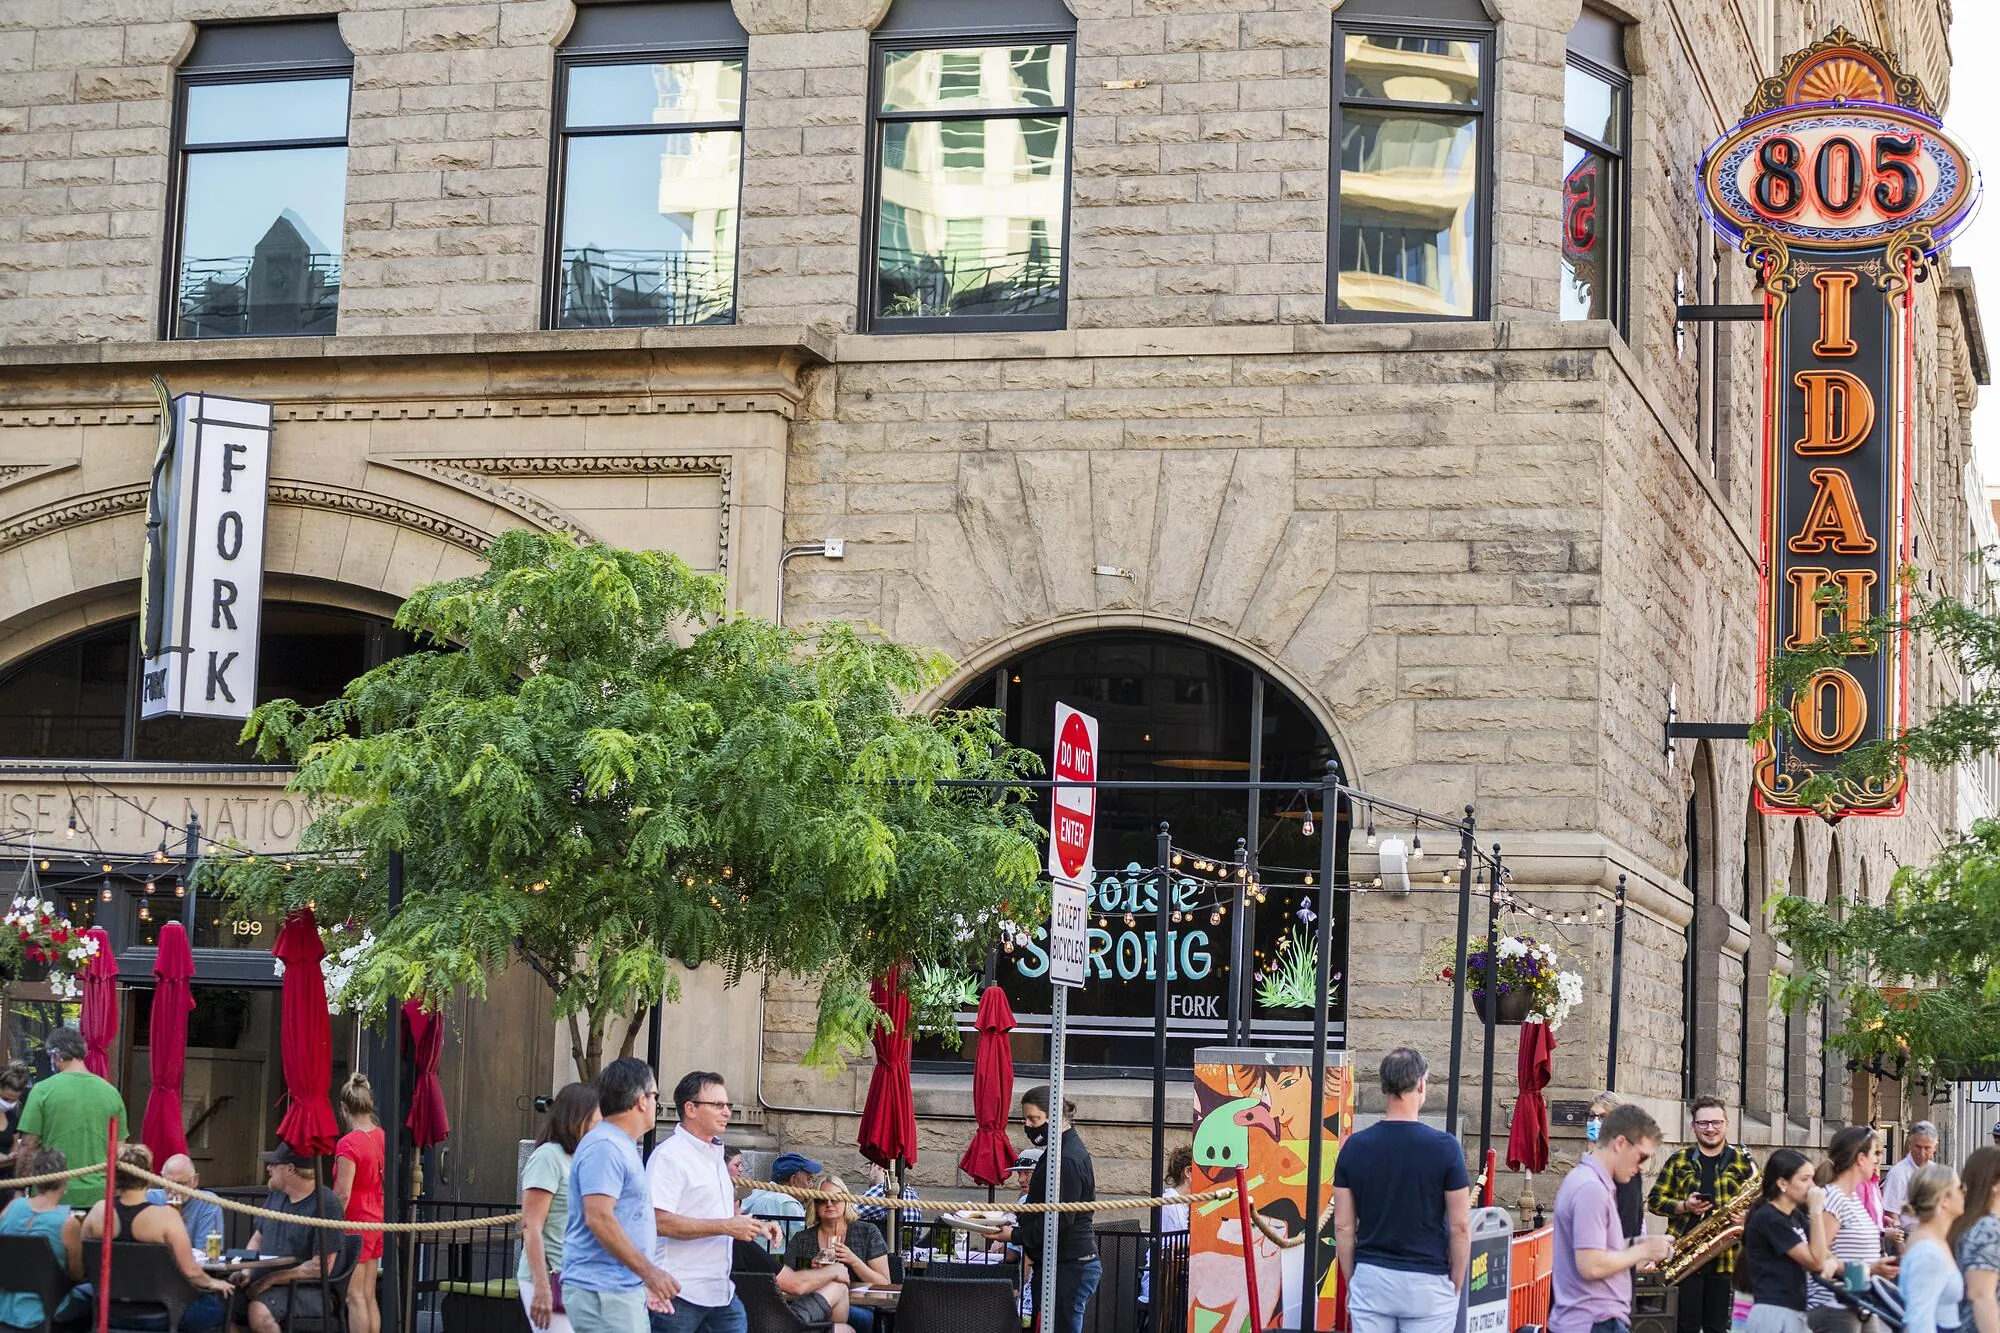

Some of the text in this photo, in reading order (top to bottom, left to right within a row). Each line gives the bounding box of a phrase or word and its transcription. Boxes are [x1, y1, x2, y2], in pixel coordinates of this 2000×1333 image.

[1752, 134, 1925, 219] 805
[1784, 270, 1878, 754] IDAHO
[205, 443, 248, 703] FORK
[1061, 740, 1091, 776] DO NOT
[68, 794, 157, 838] CITY
[1060, 816, 1085, 849] ENTER
[231, 920, 263, 936] 199
[1057, 902, 1082, 931] EXCEPT
[1016, 926, 1212, 980] SRONG
[1052, 935, 1084, 965] BICYCLES
[1170, 994, 1220, 1018] FORK
